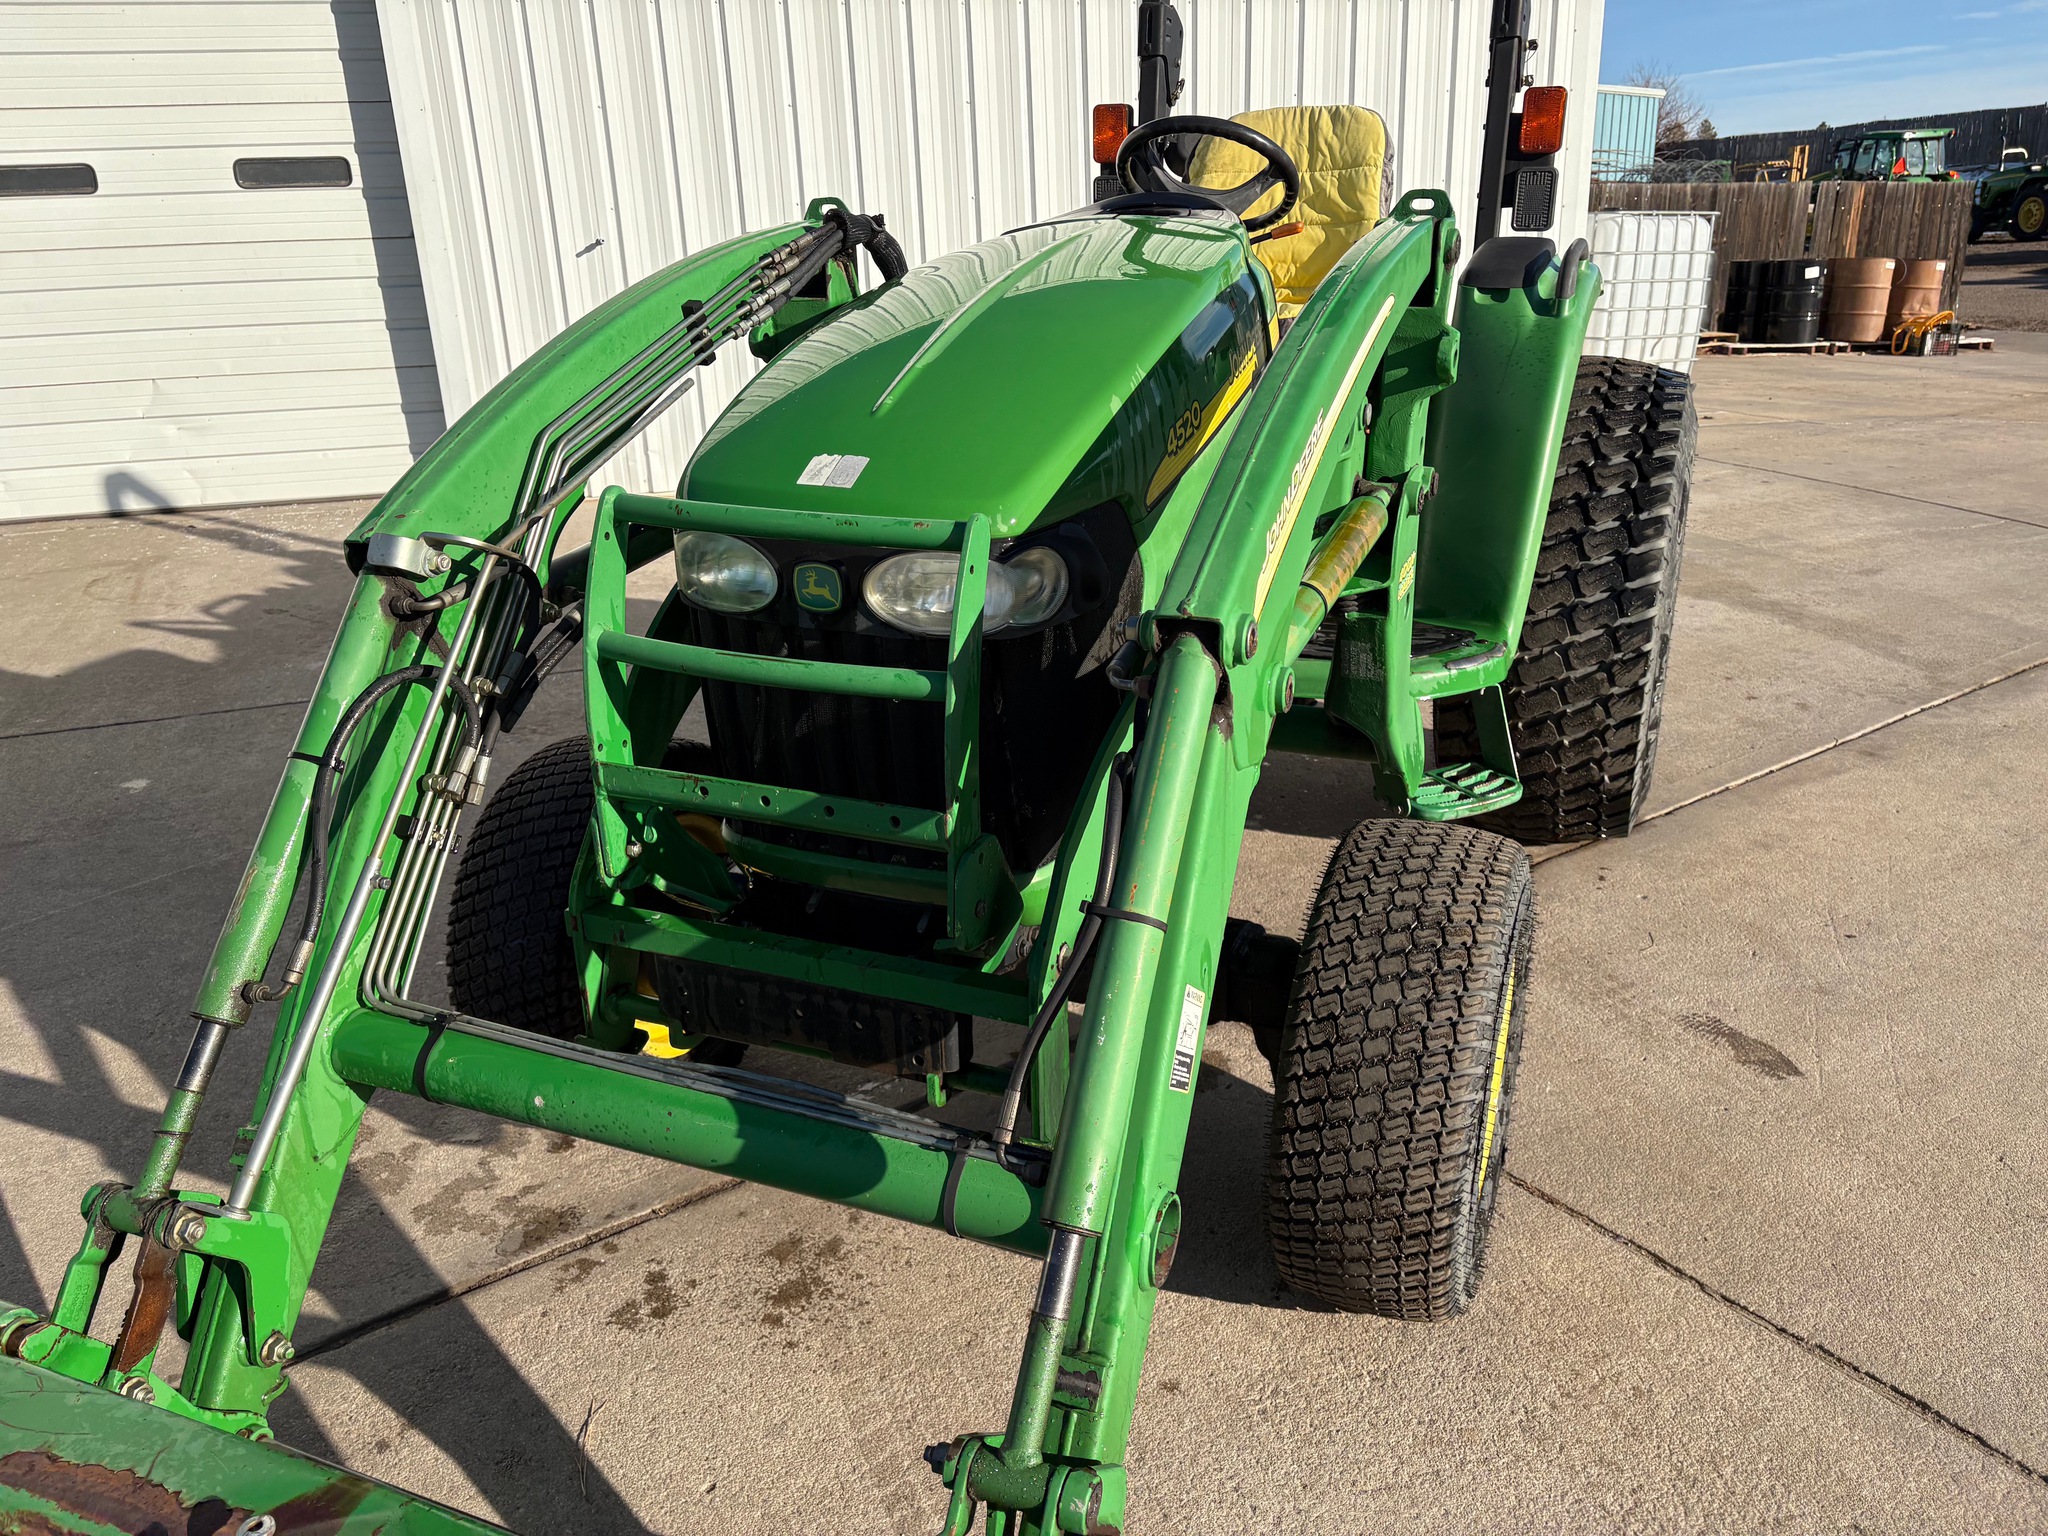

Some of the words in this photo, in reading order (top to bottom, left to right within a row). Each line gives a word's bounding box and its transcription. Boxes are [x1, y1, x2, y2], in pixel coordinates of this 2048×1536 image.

[1167, 400, 1202, 458] 4520
[1264, 486, 1292, 574] JOHN
[1291, 406, 1324, 505] DEERE
